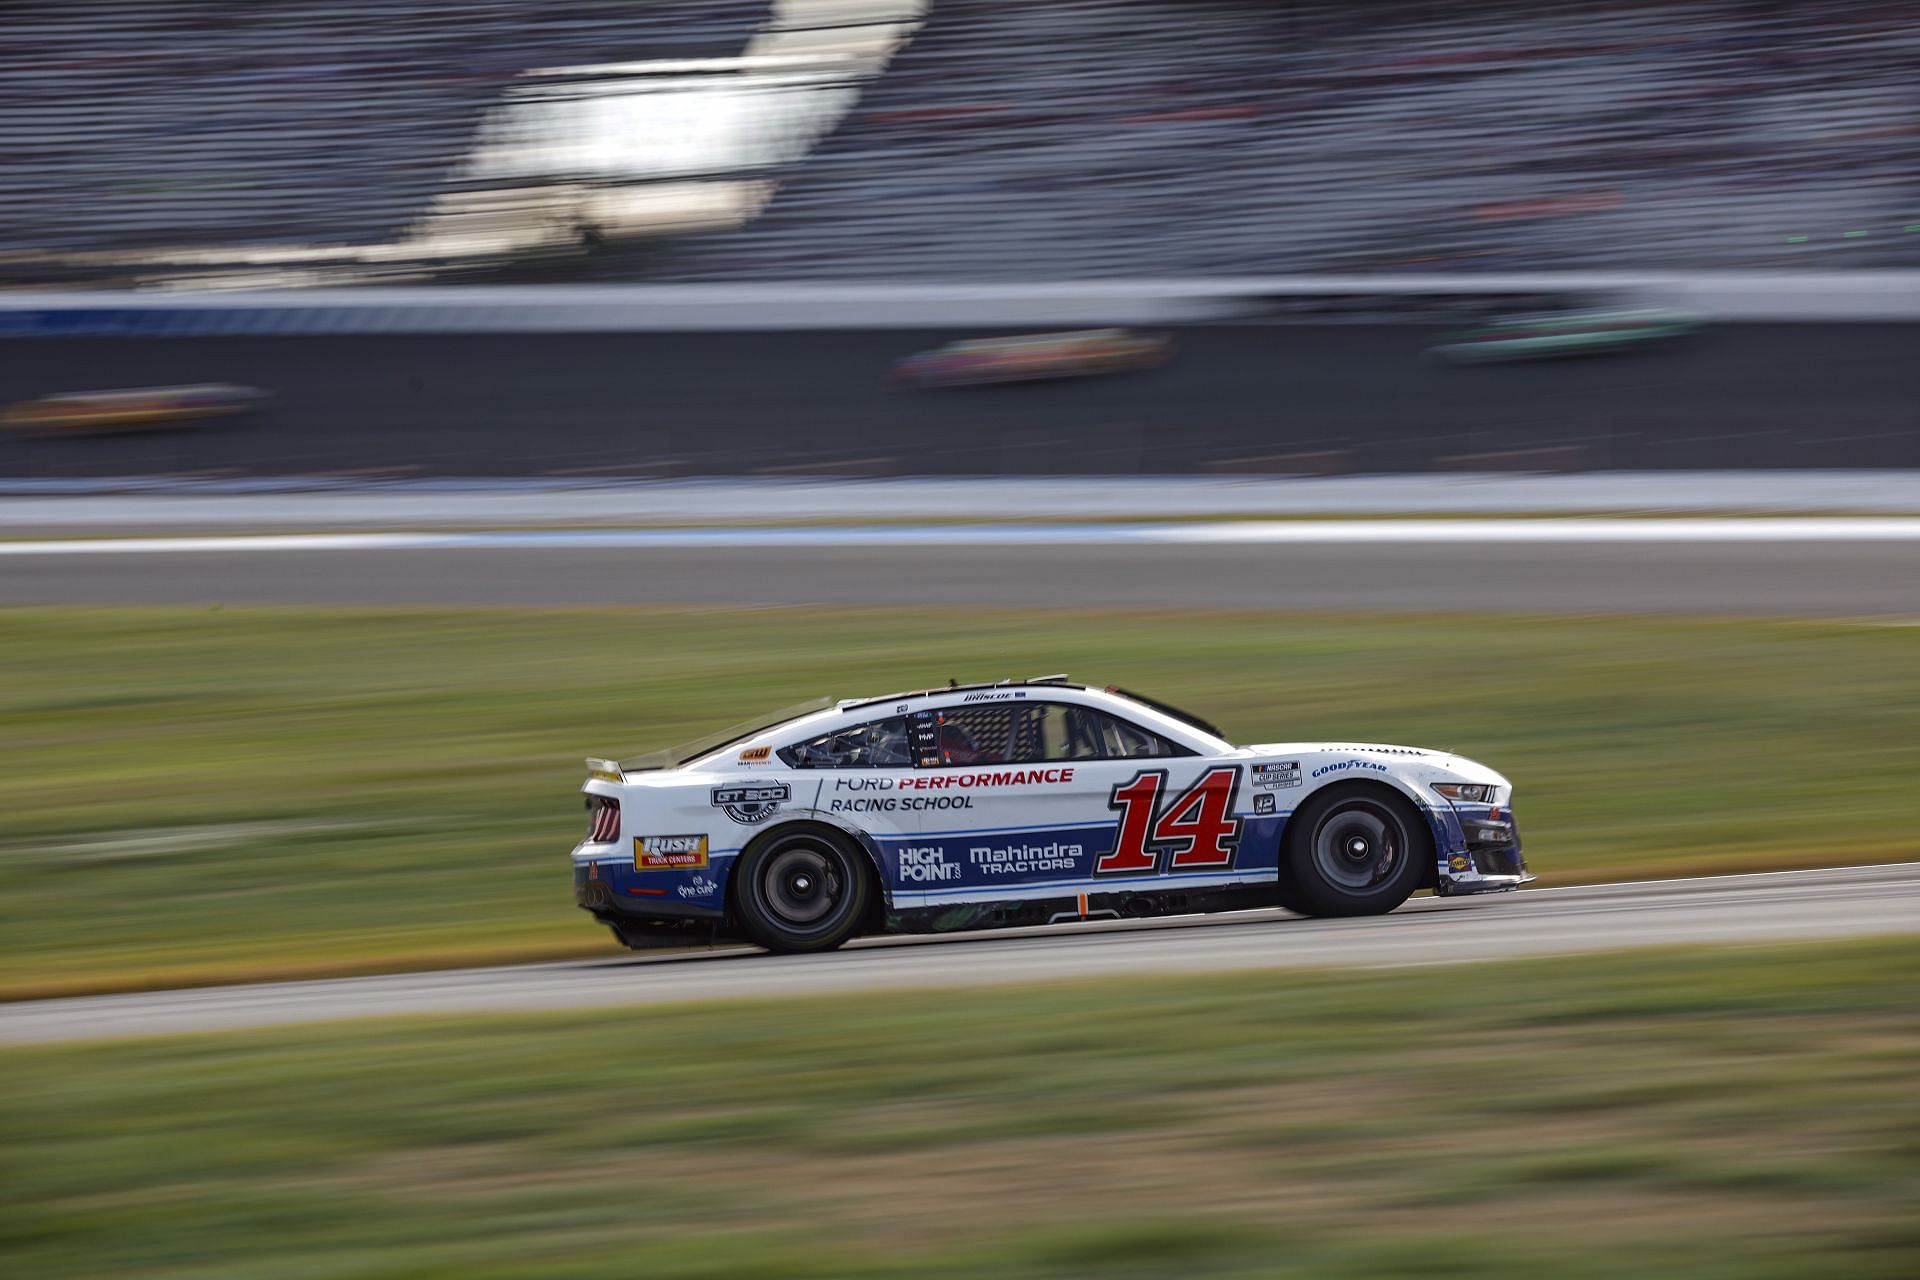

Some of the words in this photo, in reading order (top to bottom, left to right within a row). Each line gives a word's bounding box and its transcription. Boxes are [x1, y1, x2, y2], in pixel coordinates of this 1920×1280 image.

[1266, 763, 1293, 772] NASCAR
[1312, 760, 1387, 778] GOODYEAR
[835, 778, 894, 791] FORD
[898, 768, 1075, 790] PERFORMANCE
[830, 798, 897, 812] RACING
[899, 796, 974, 811] SCHOOL
[1094, 766, 1243, 877] 14
[647, 856, 668, 865] TRUCK
[668, 855, 696, 865] CENTERS
[899, 847, 944, 865] HIGH
[969, 842, 1083, 864] Mahindra
[899, 862, 955, 882] POINT
[979, 858, 1075, 875] TRACTORS
